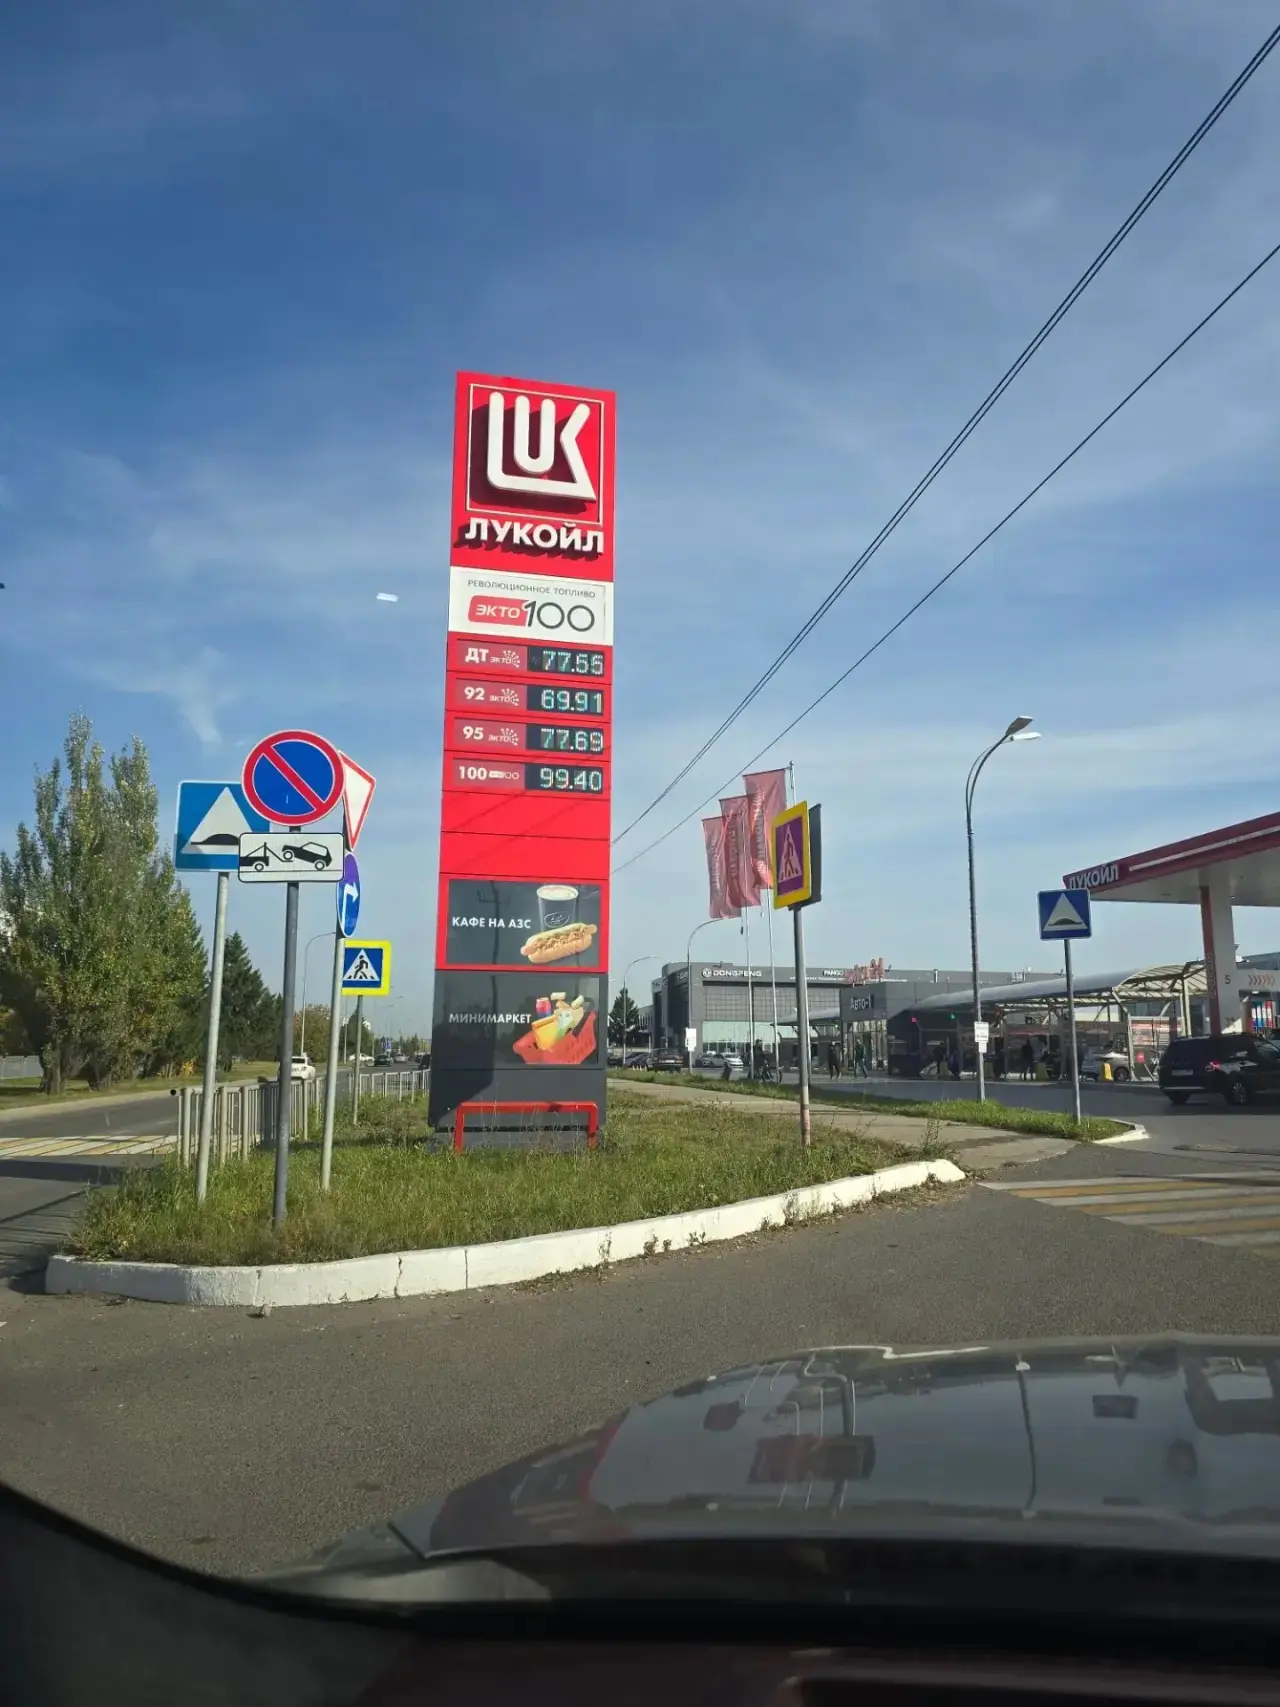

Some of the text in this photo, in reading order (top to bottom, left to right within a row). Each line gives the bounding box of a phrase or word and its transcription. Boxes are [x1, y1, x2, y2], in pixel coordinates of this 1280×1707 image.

[465, 517, 604, 553] ЛУКОЙЛ
[468, 579, 596, 599] РЕВОЛЮЦИОННОЕ ТОПЛИВО
[475, 600, 595, 632] ЭКТО 100
[465, 647, 489, 664] ДТ
[464, 687, 485, 700] 92
[541, 689, 602, 713] 69.91
[463, 726, 484, 740] 95
[541, 728, 603, 752] 77.69
[459, 766, 487, 780] 100
[540, 767, 602, 791] 99.40
[452, 917, 531, 929] КАФЕ НА АЗС
[1224, 974, 1231, 985] 5
[449, 1013, 531, 1025] МИНИМАРКЕТ
